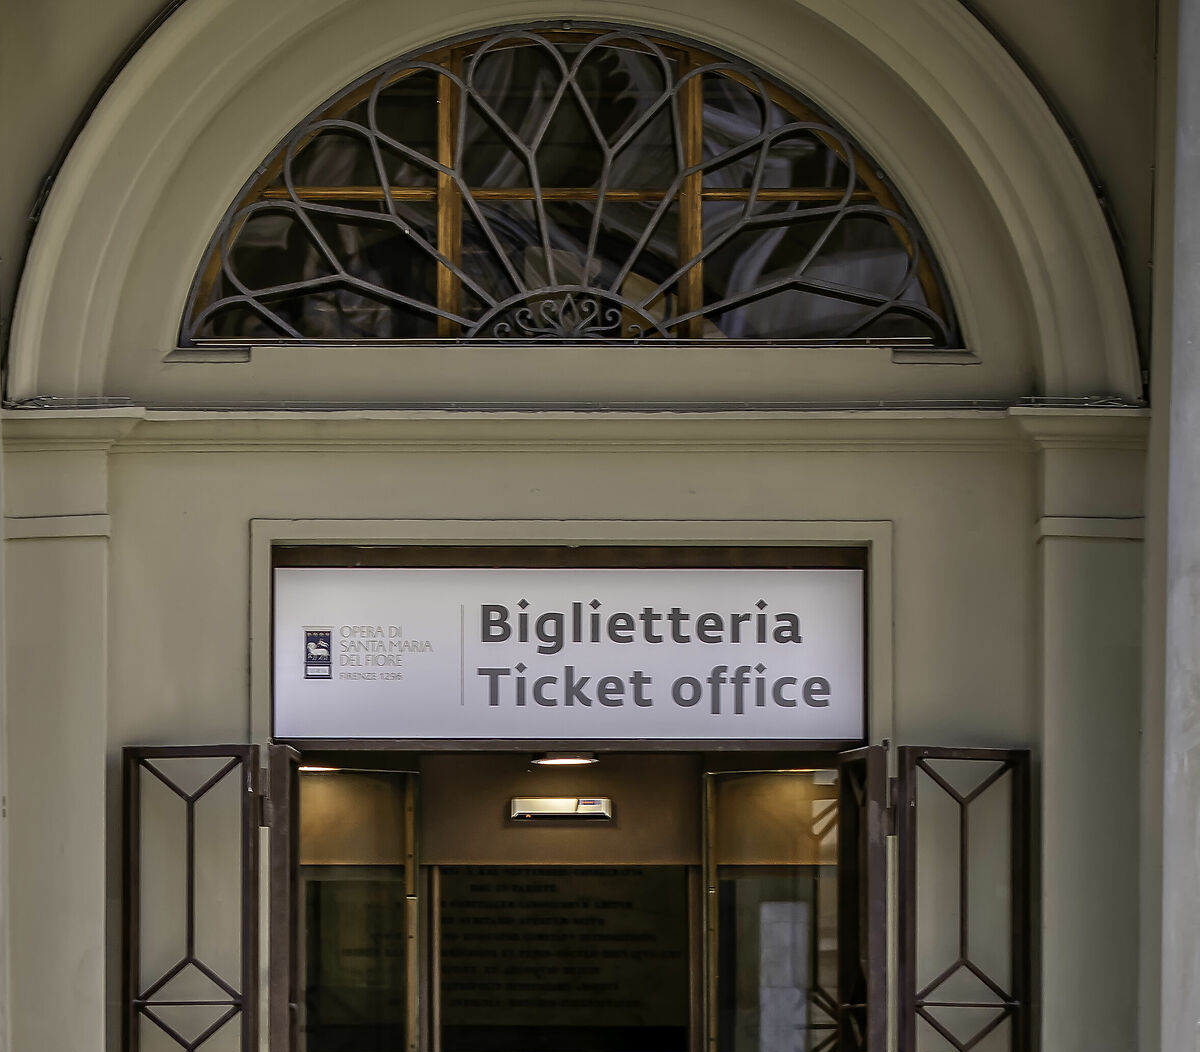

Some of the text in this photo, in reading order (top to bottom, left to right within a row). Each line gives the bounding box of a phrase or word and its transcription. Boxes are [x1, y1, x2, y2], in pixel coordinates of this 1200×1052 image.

[339, 625, 402, 639] OPERA DI
[480, 598, 804, 655] Biglietteria
[340, 639, 434, 653] SANTA MARIA
[340, 654, 403, 667] DEL FIORE
[339, 672, 377, 681] FIRENZE
[476, 662, 833, 716] Ticket office
